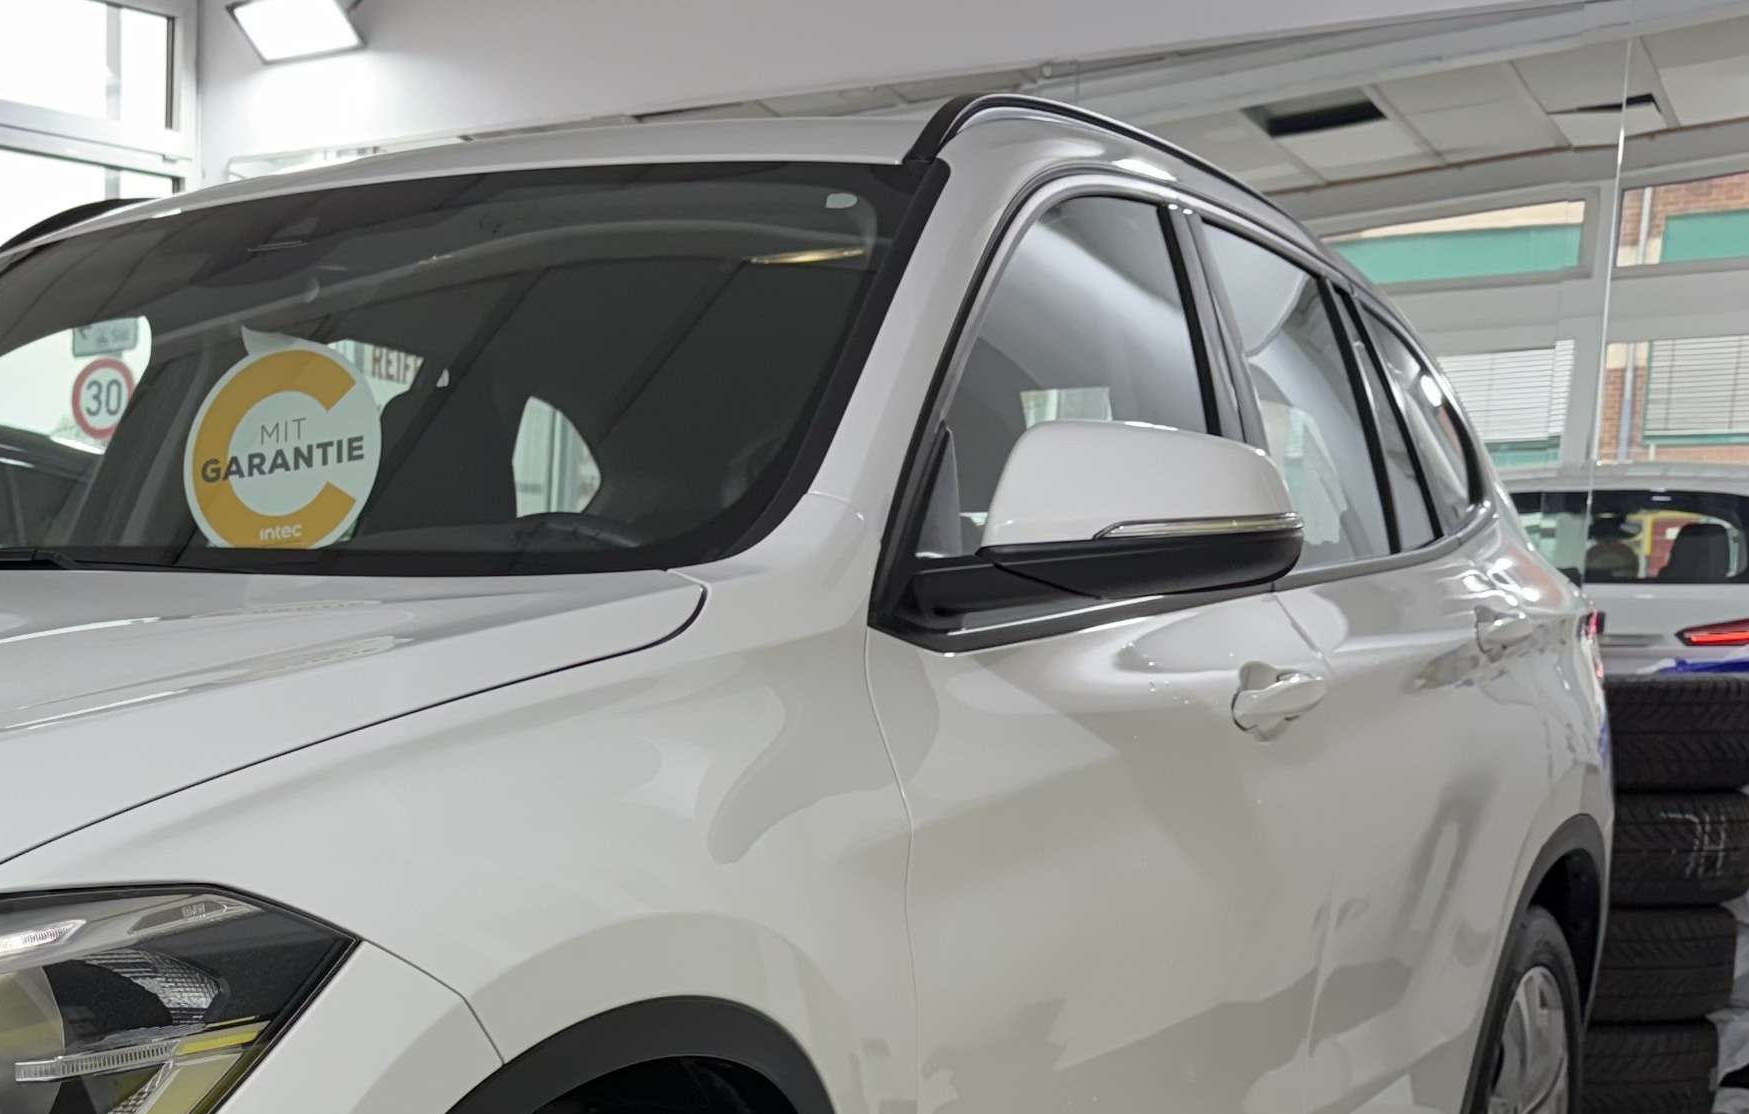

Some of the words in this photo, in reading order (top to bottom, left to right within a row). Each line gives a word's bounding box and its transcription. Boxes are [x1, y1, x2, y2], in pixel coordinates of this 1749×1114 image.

[85, 379, 122, 417] 30
[260, 417, 307, 446] MIT
[200, 435, 365, 484] GARANTIE
